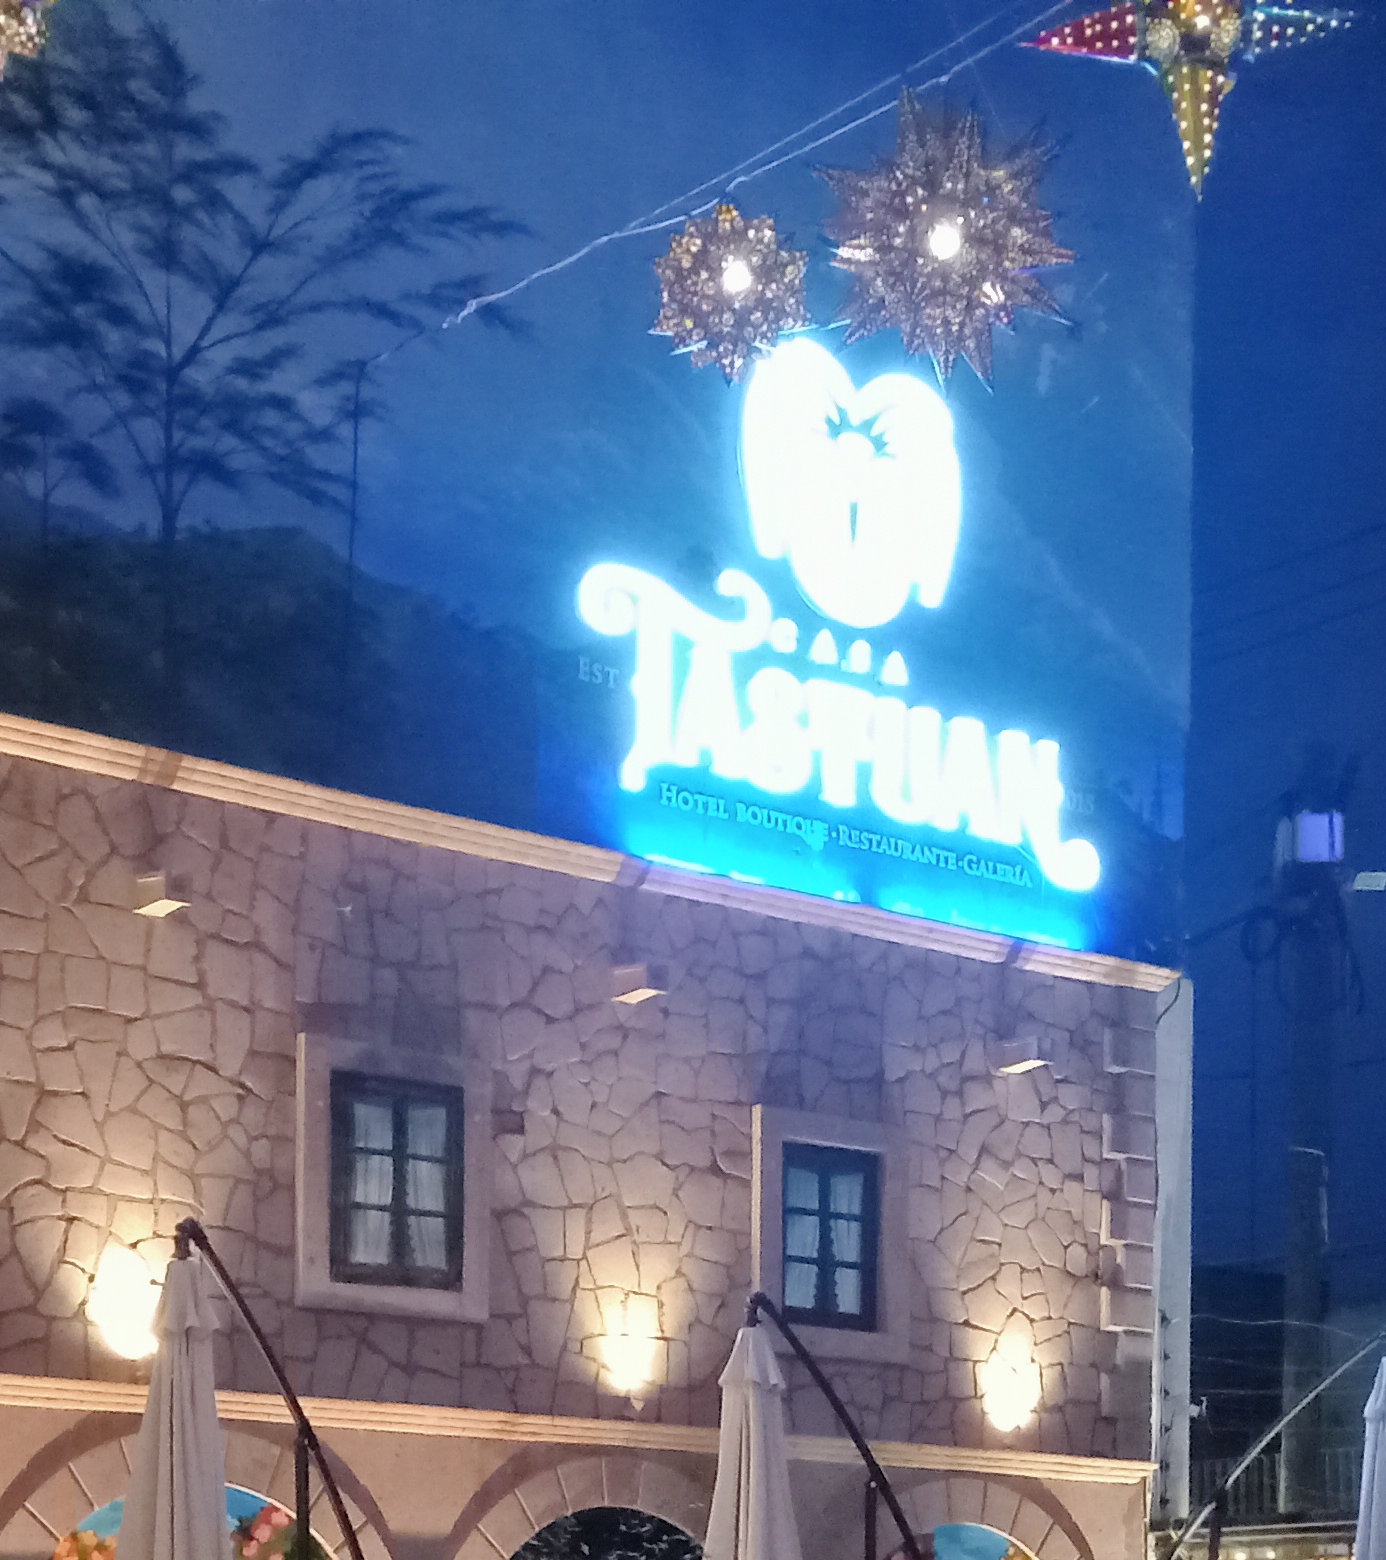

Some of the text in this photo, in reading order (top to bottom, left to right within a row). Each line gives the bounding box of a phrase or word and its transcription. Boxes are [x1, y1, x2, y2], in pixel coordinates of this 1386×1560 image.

[578, 656, 620, 689] EST
[659, 782, 730, 820] HOTEL
[837, 824, 959, 871] RESTAURANTE
